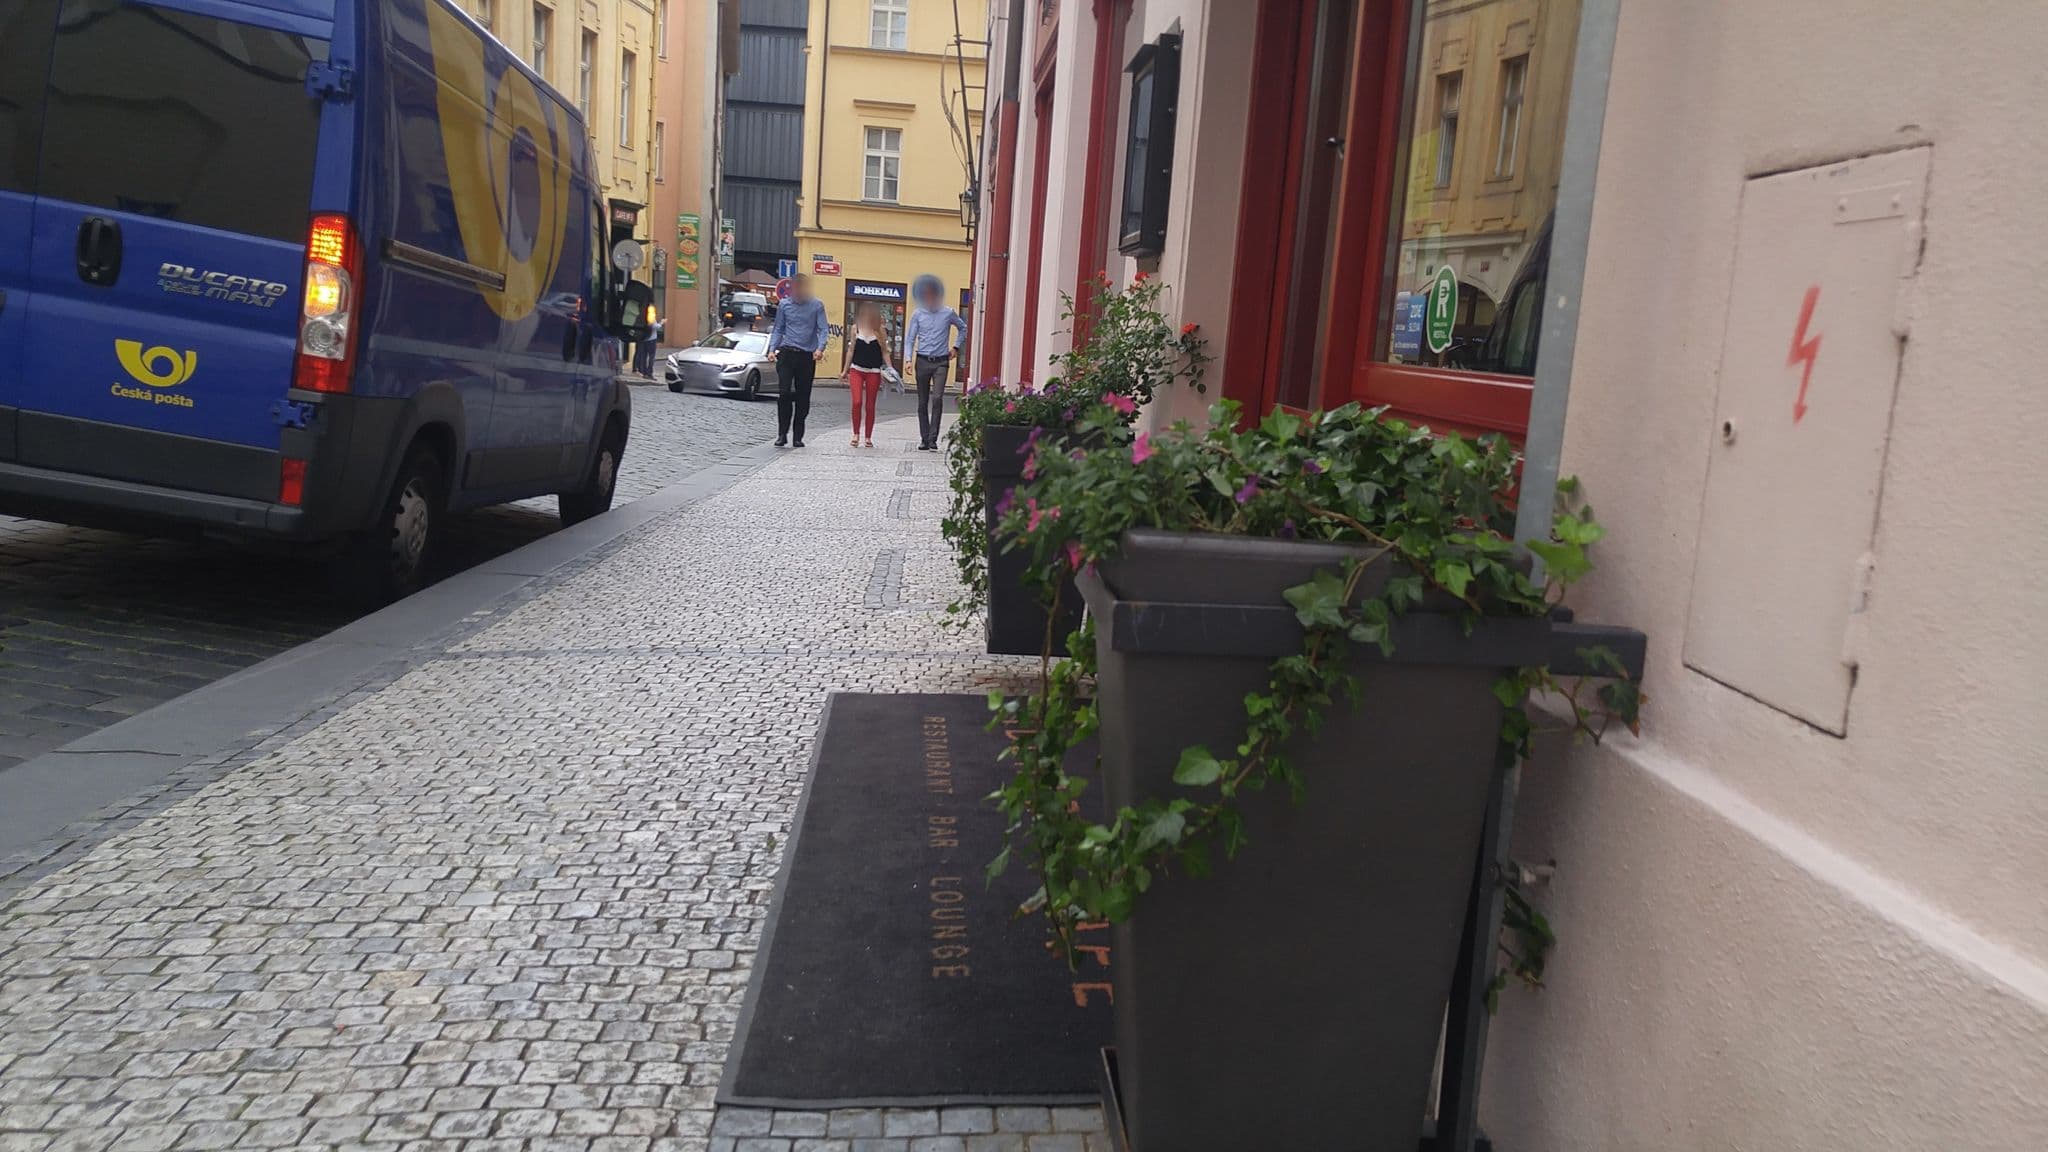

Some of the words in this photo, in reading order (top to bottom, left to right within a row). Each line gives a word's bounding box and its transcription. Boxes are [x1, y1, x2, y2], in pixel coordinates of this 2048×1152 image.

[159, 263, 287, 297] DUCATO
[854, 285, 900, 297] BOHEMIA
[205, 287, 276, 308] MAXI
[111, 382, 152, 400] Česká
[155, 392, 194, 407] pošta
[924, 715, 953, 795] RESTAURANT
[928, 815, 959, 848] BAR
[930, 876, 972, 978] LOUNGE
